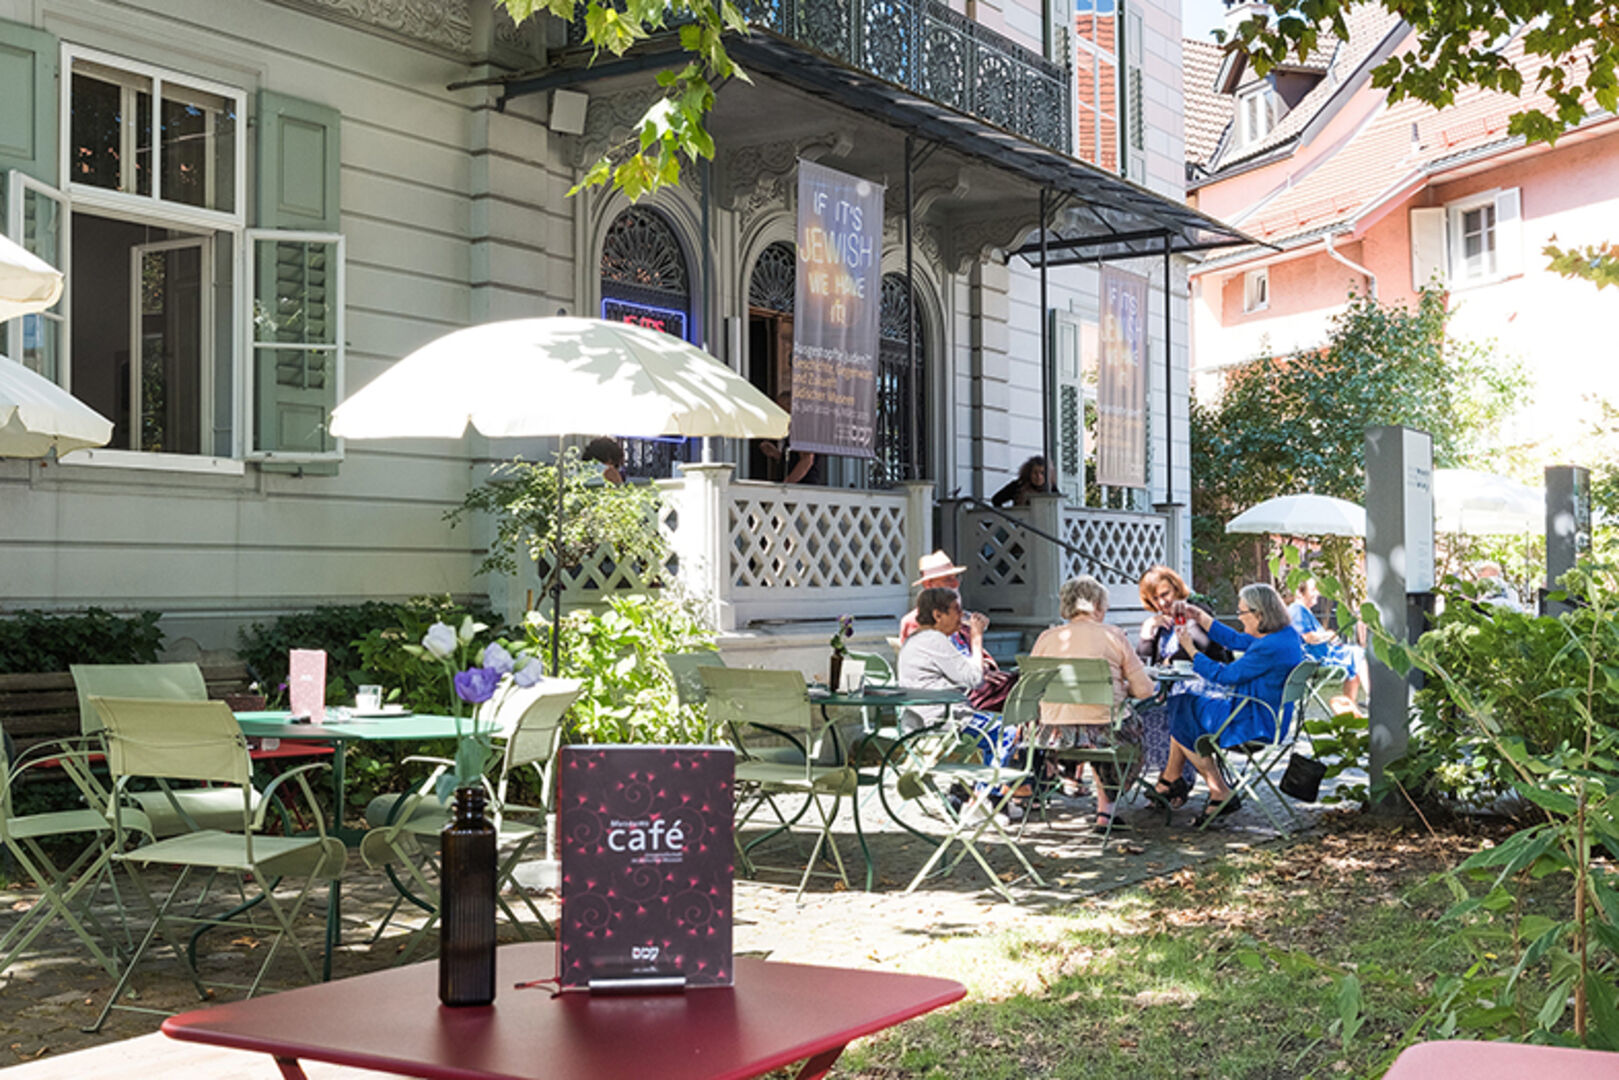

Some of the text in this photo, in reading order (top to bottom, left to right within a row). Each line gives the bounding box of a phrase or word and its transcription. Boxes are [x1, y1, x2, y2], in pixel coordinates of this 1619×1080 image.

[813, 191, 828, 217] IF
[800, 227, 873, 268] JEWISH
[808, 272, 829, 296] WE
[608, 819, 684, 851] café
